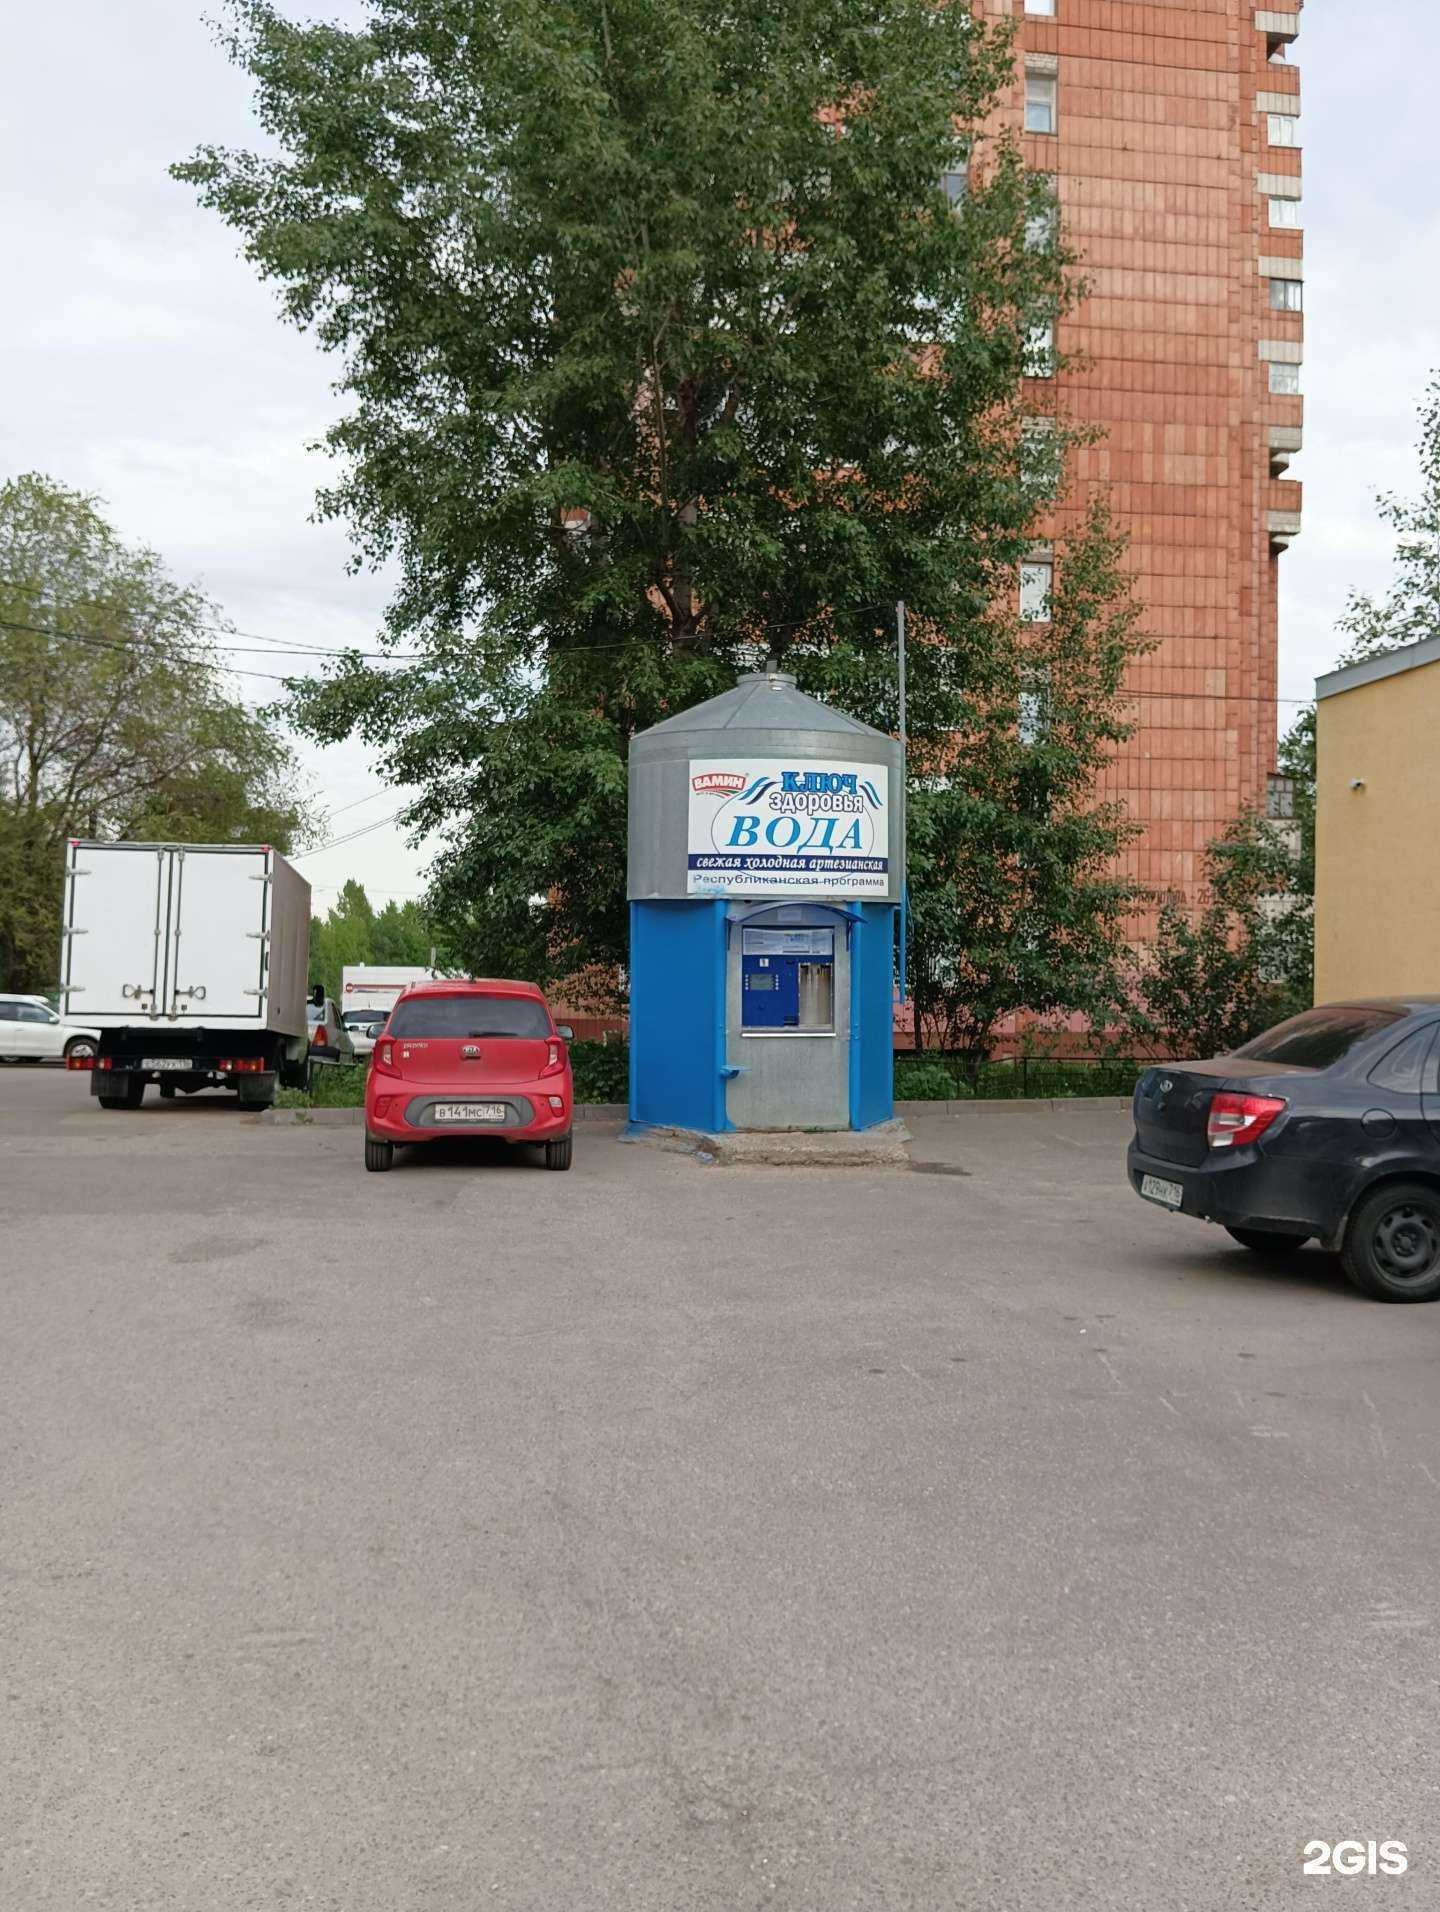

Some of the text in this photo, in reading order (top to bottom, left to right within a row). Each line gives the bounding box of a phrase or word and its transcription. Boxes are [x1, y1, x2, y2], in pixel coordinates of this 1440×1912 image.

[694, 775, 745, 790] ВАМИН
[781, 772, 858, 795] КЛЮЧ
[725, 815, 863, 854] ВОДА
[696, 855, 884, 872] свежая холодная артезианская
[693, 874, 885, 888] Республиканская программа
